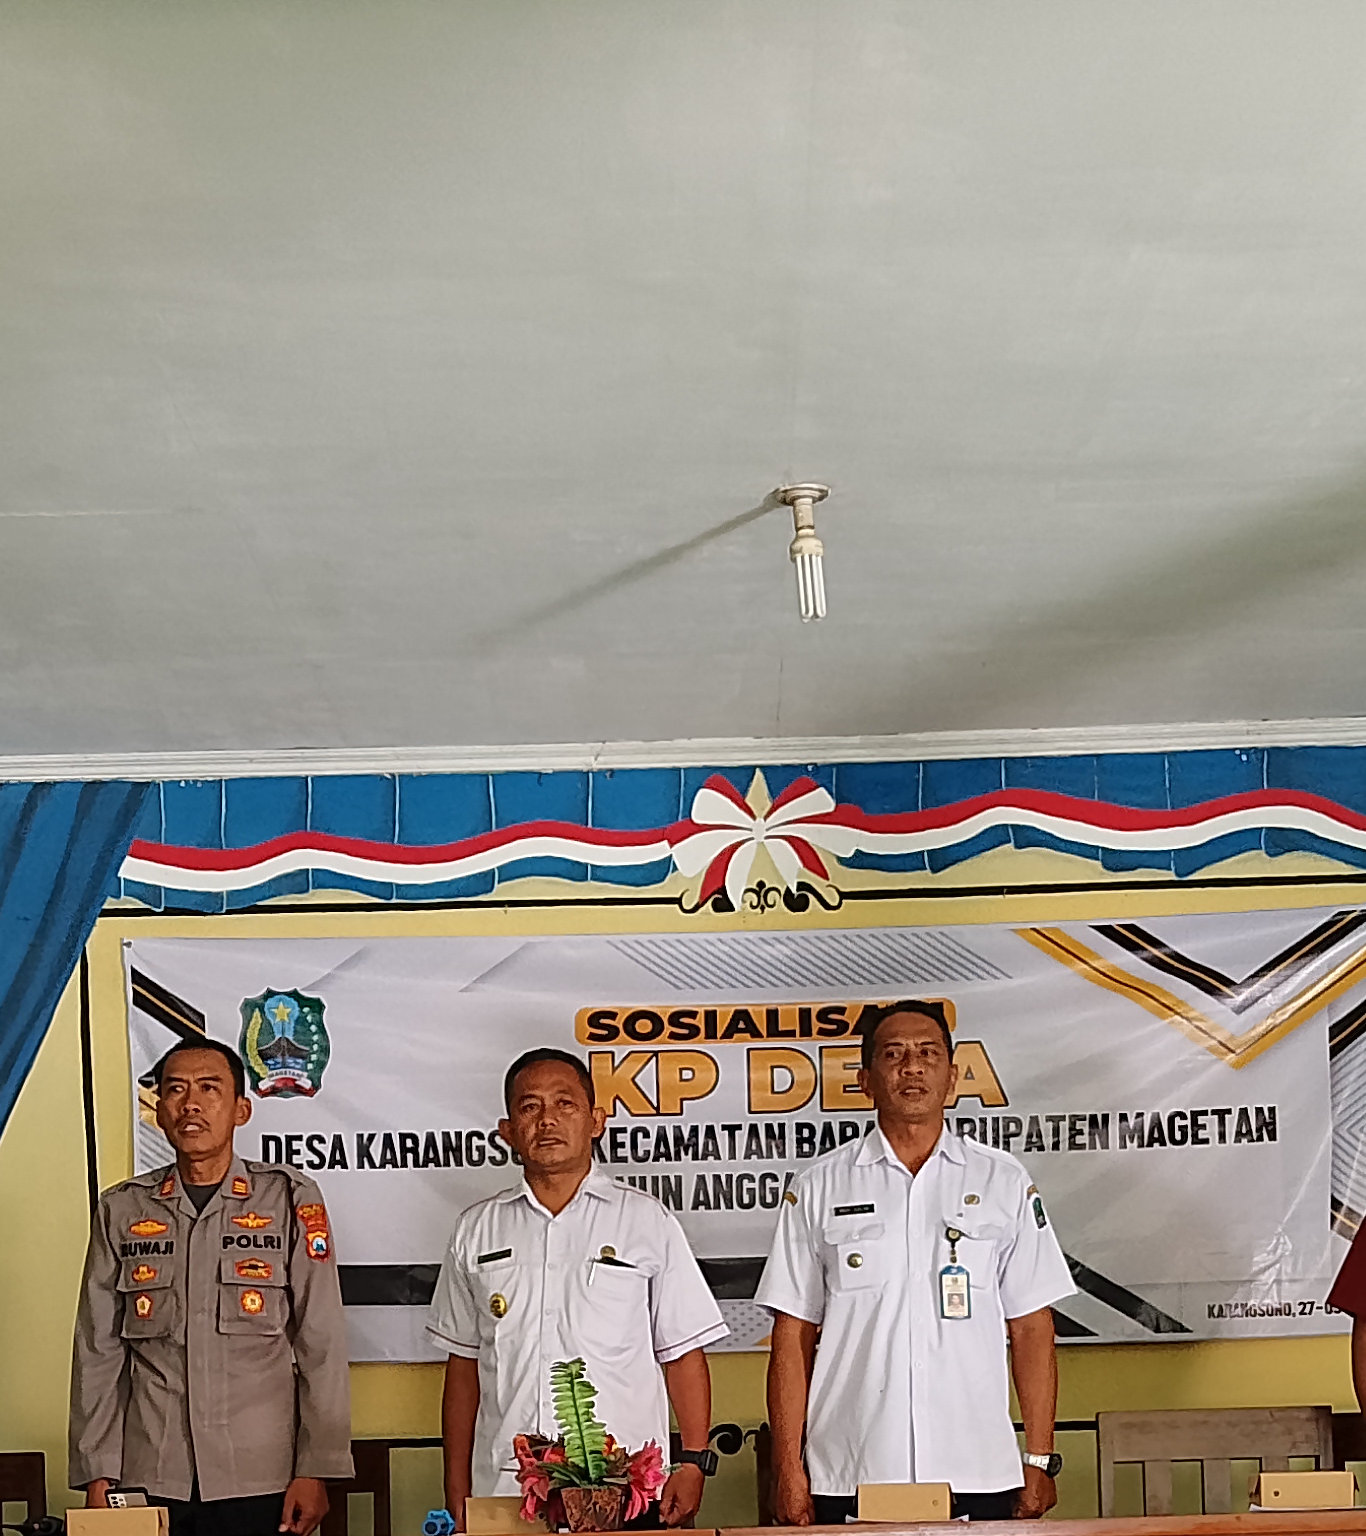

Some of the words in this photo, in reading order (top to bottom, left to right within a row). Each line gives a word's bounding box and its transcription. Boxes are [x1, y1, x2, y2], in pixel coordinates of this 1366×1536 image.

[586, 1002, 944, 1041] SOSIALIS
[747, 1040, 1009, 1114] DEA
[261, 1133, 349, 1170] DESA
[356, 1129, 524, 1169] KARANGS
[795, 1120, 876, 1159] BAR
[944, 1112, 1110, 1152] BUPATEN
[1118, 1105, 1278, 1149] MAGETAN
[690, 1171, 795, 1211] ANGG
[221, 1234, 282, 1250] POLRI
[1297, 1300, 1342, 1315] 27-0
